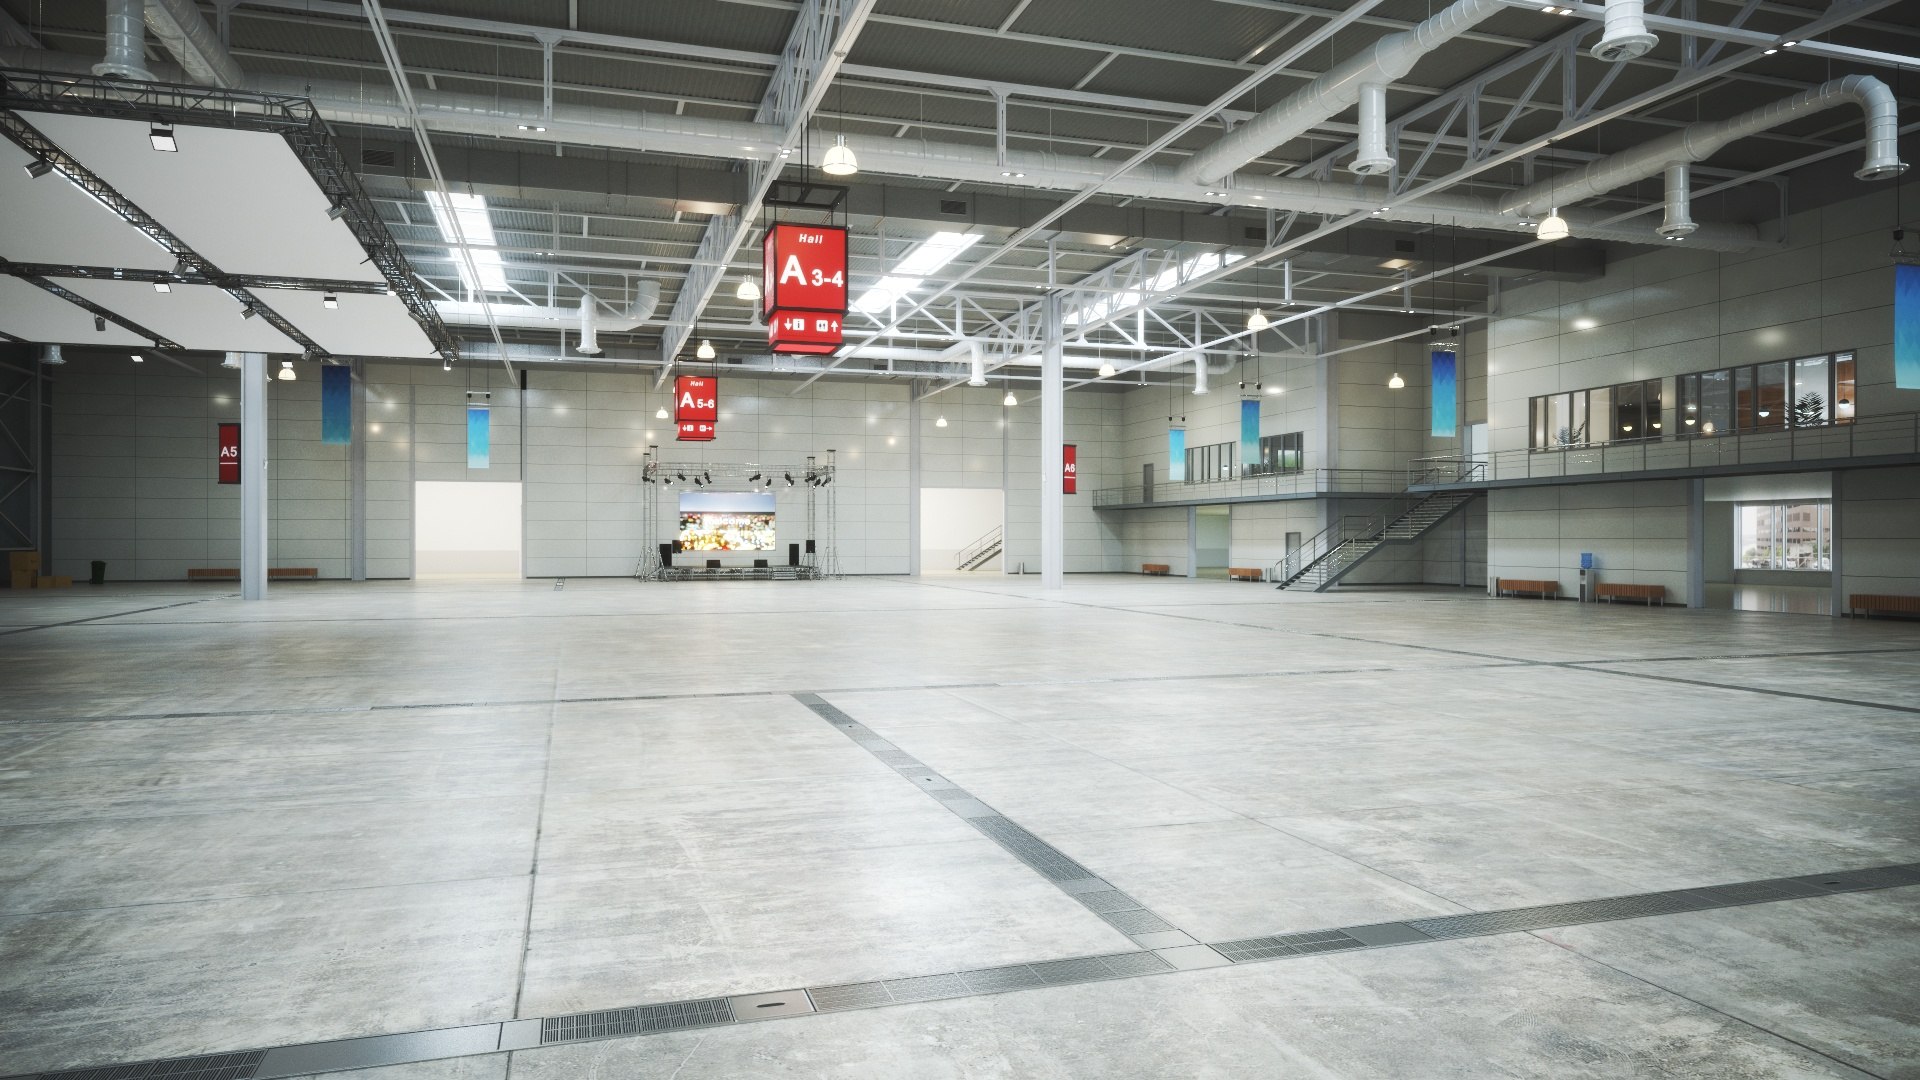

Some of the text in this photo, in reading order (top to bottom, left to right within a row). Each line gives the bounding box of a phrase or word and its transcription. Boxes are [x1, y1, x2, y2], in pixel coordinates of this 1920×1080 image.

[799, 234, 823, 244] Hall
[780, 254, 808, 286] A
[811, 268, 844, 288] 3-4
[680, 391, 715, 409] A 5-6
[220, 446, 238, 458] A5
[1064, 462, 1076, 473] A6
